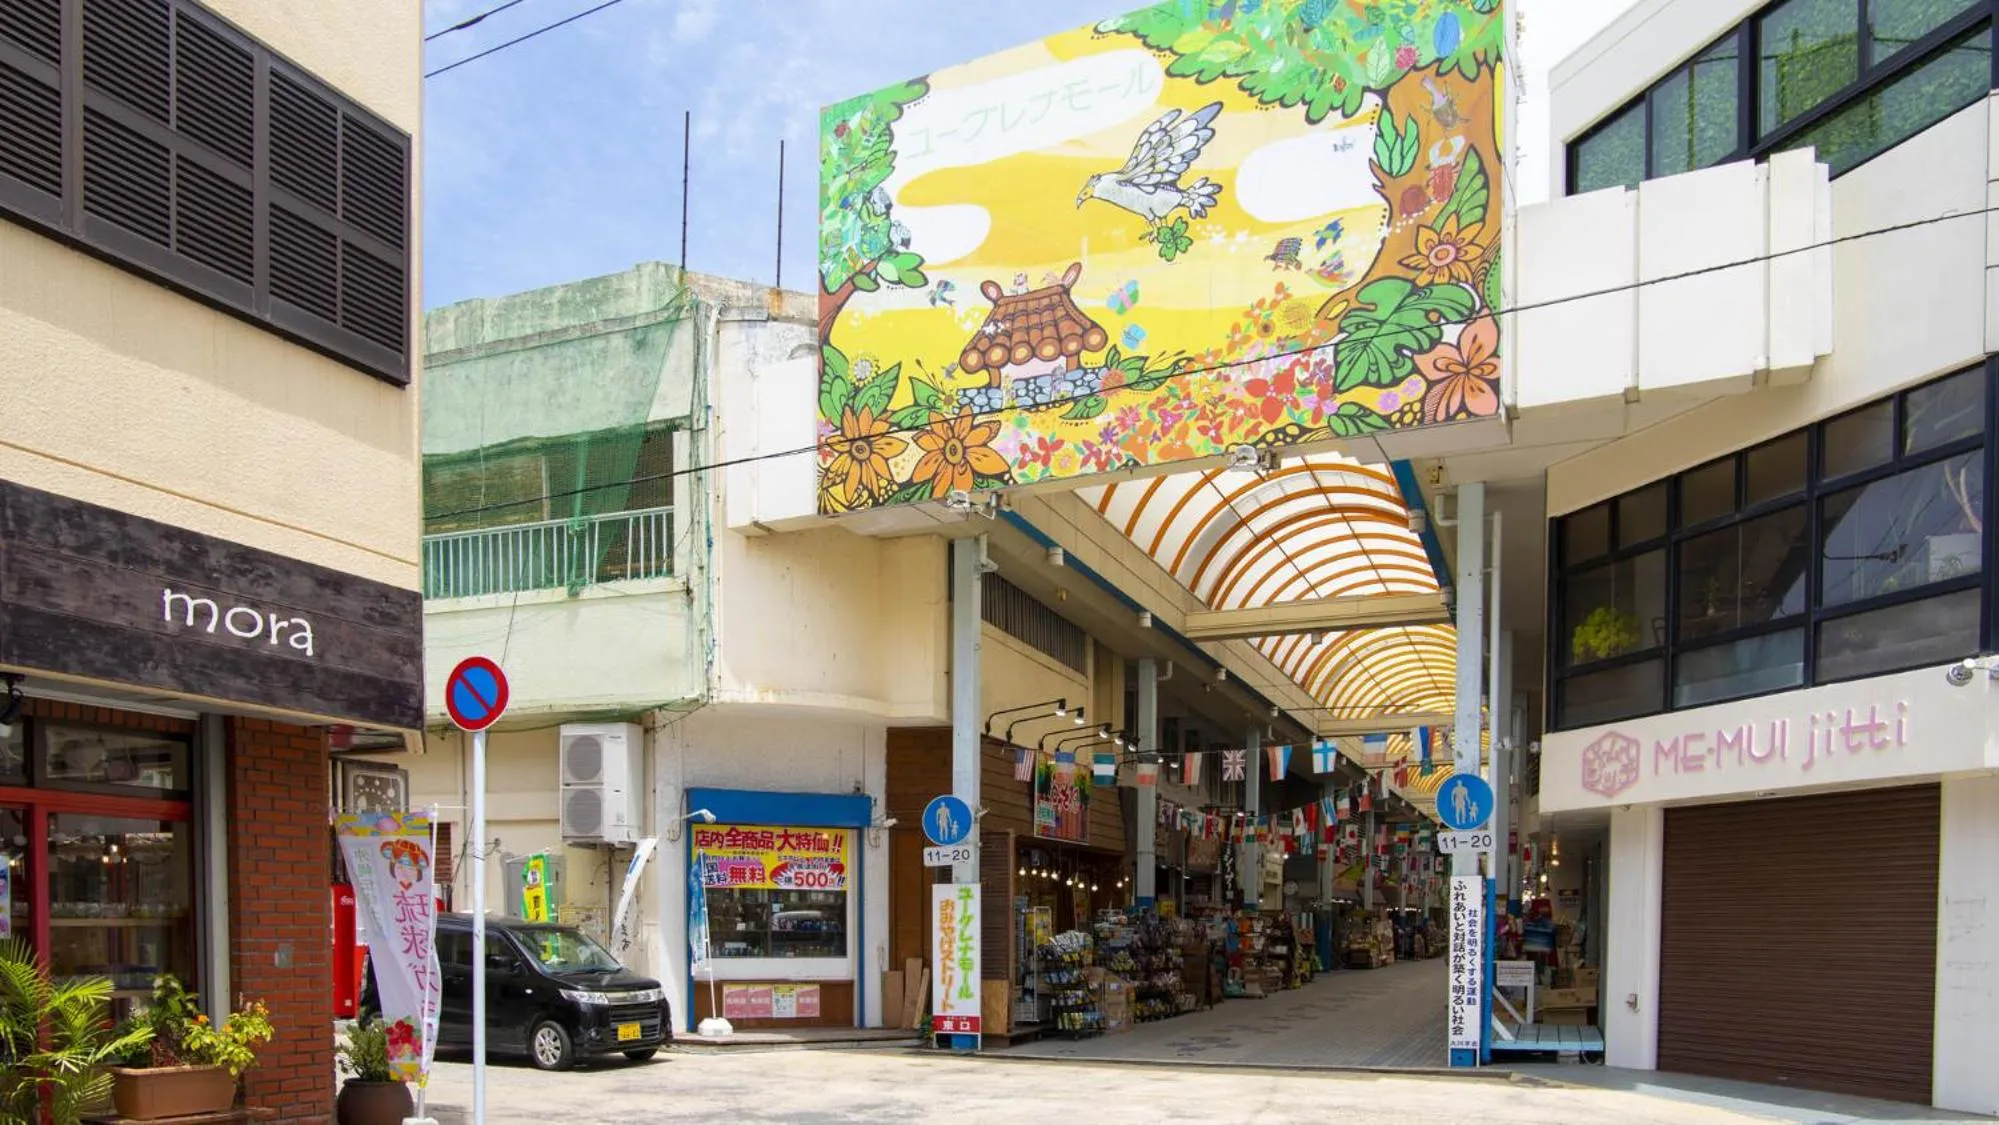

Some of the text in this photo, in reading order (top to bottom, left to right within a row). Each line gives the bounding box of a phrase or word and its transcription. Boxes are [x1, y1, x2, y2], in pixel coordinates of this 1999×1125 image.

[162, 587, 314, 657] mora
[1800, 700, 1909, 772] jitti
[926, 848, 971, 862] 11-20
[1441, 833, 1492, 850] 11-20
[1451, 881, 1467, 1037] ふれあいと対話が築く明るい社会
[1466, 908, 1479, 1006] 社会を明るくする運動
